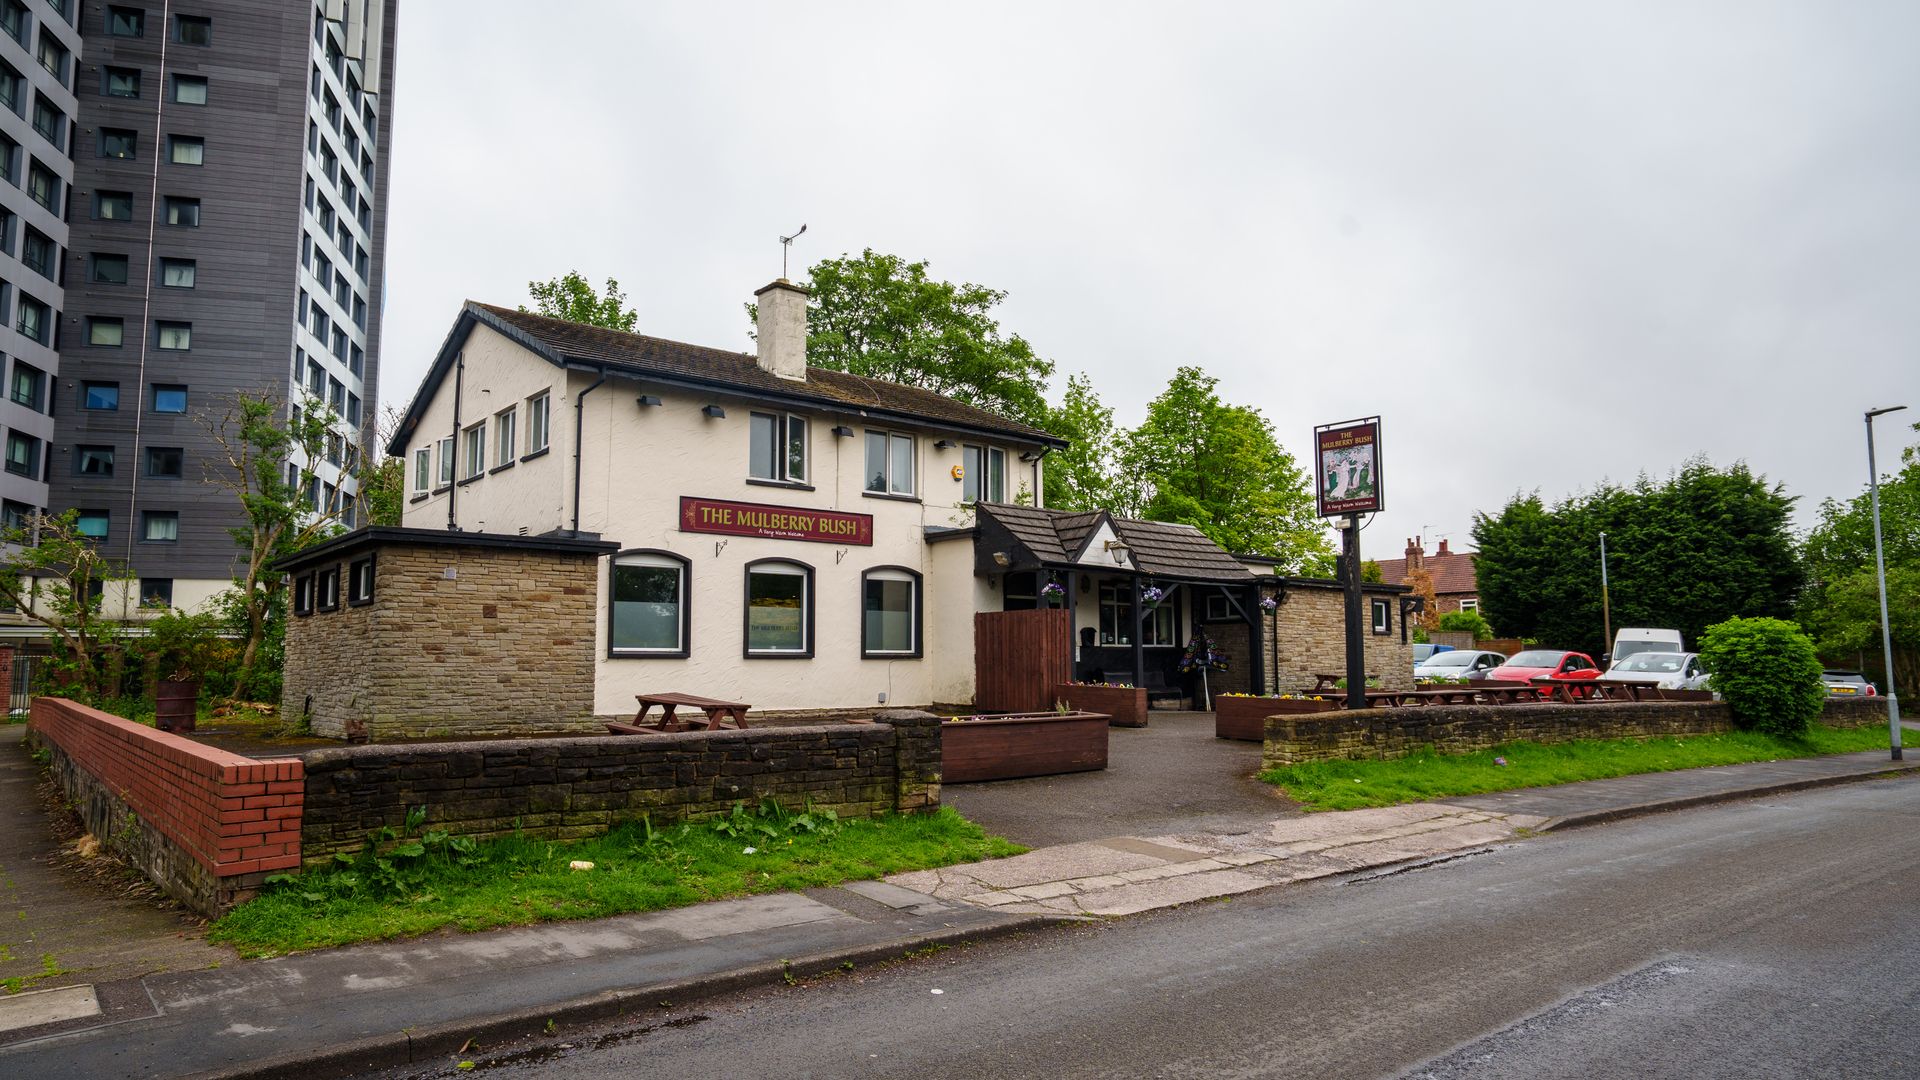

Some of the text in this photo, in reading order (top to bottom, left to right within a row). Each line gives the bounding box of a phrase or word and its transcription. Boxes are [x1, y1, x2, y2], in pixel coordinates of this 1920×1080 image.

[1322, 435, 1372, 449] MULBERRY BUSH
[1340, 431, 1353, 439] THE
[701, 507, 857, 535] THE MULBERRY BUSH
